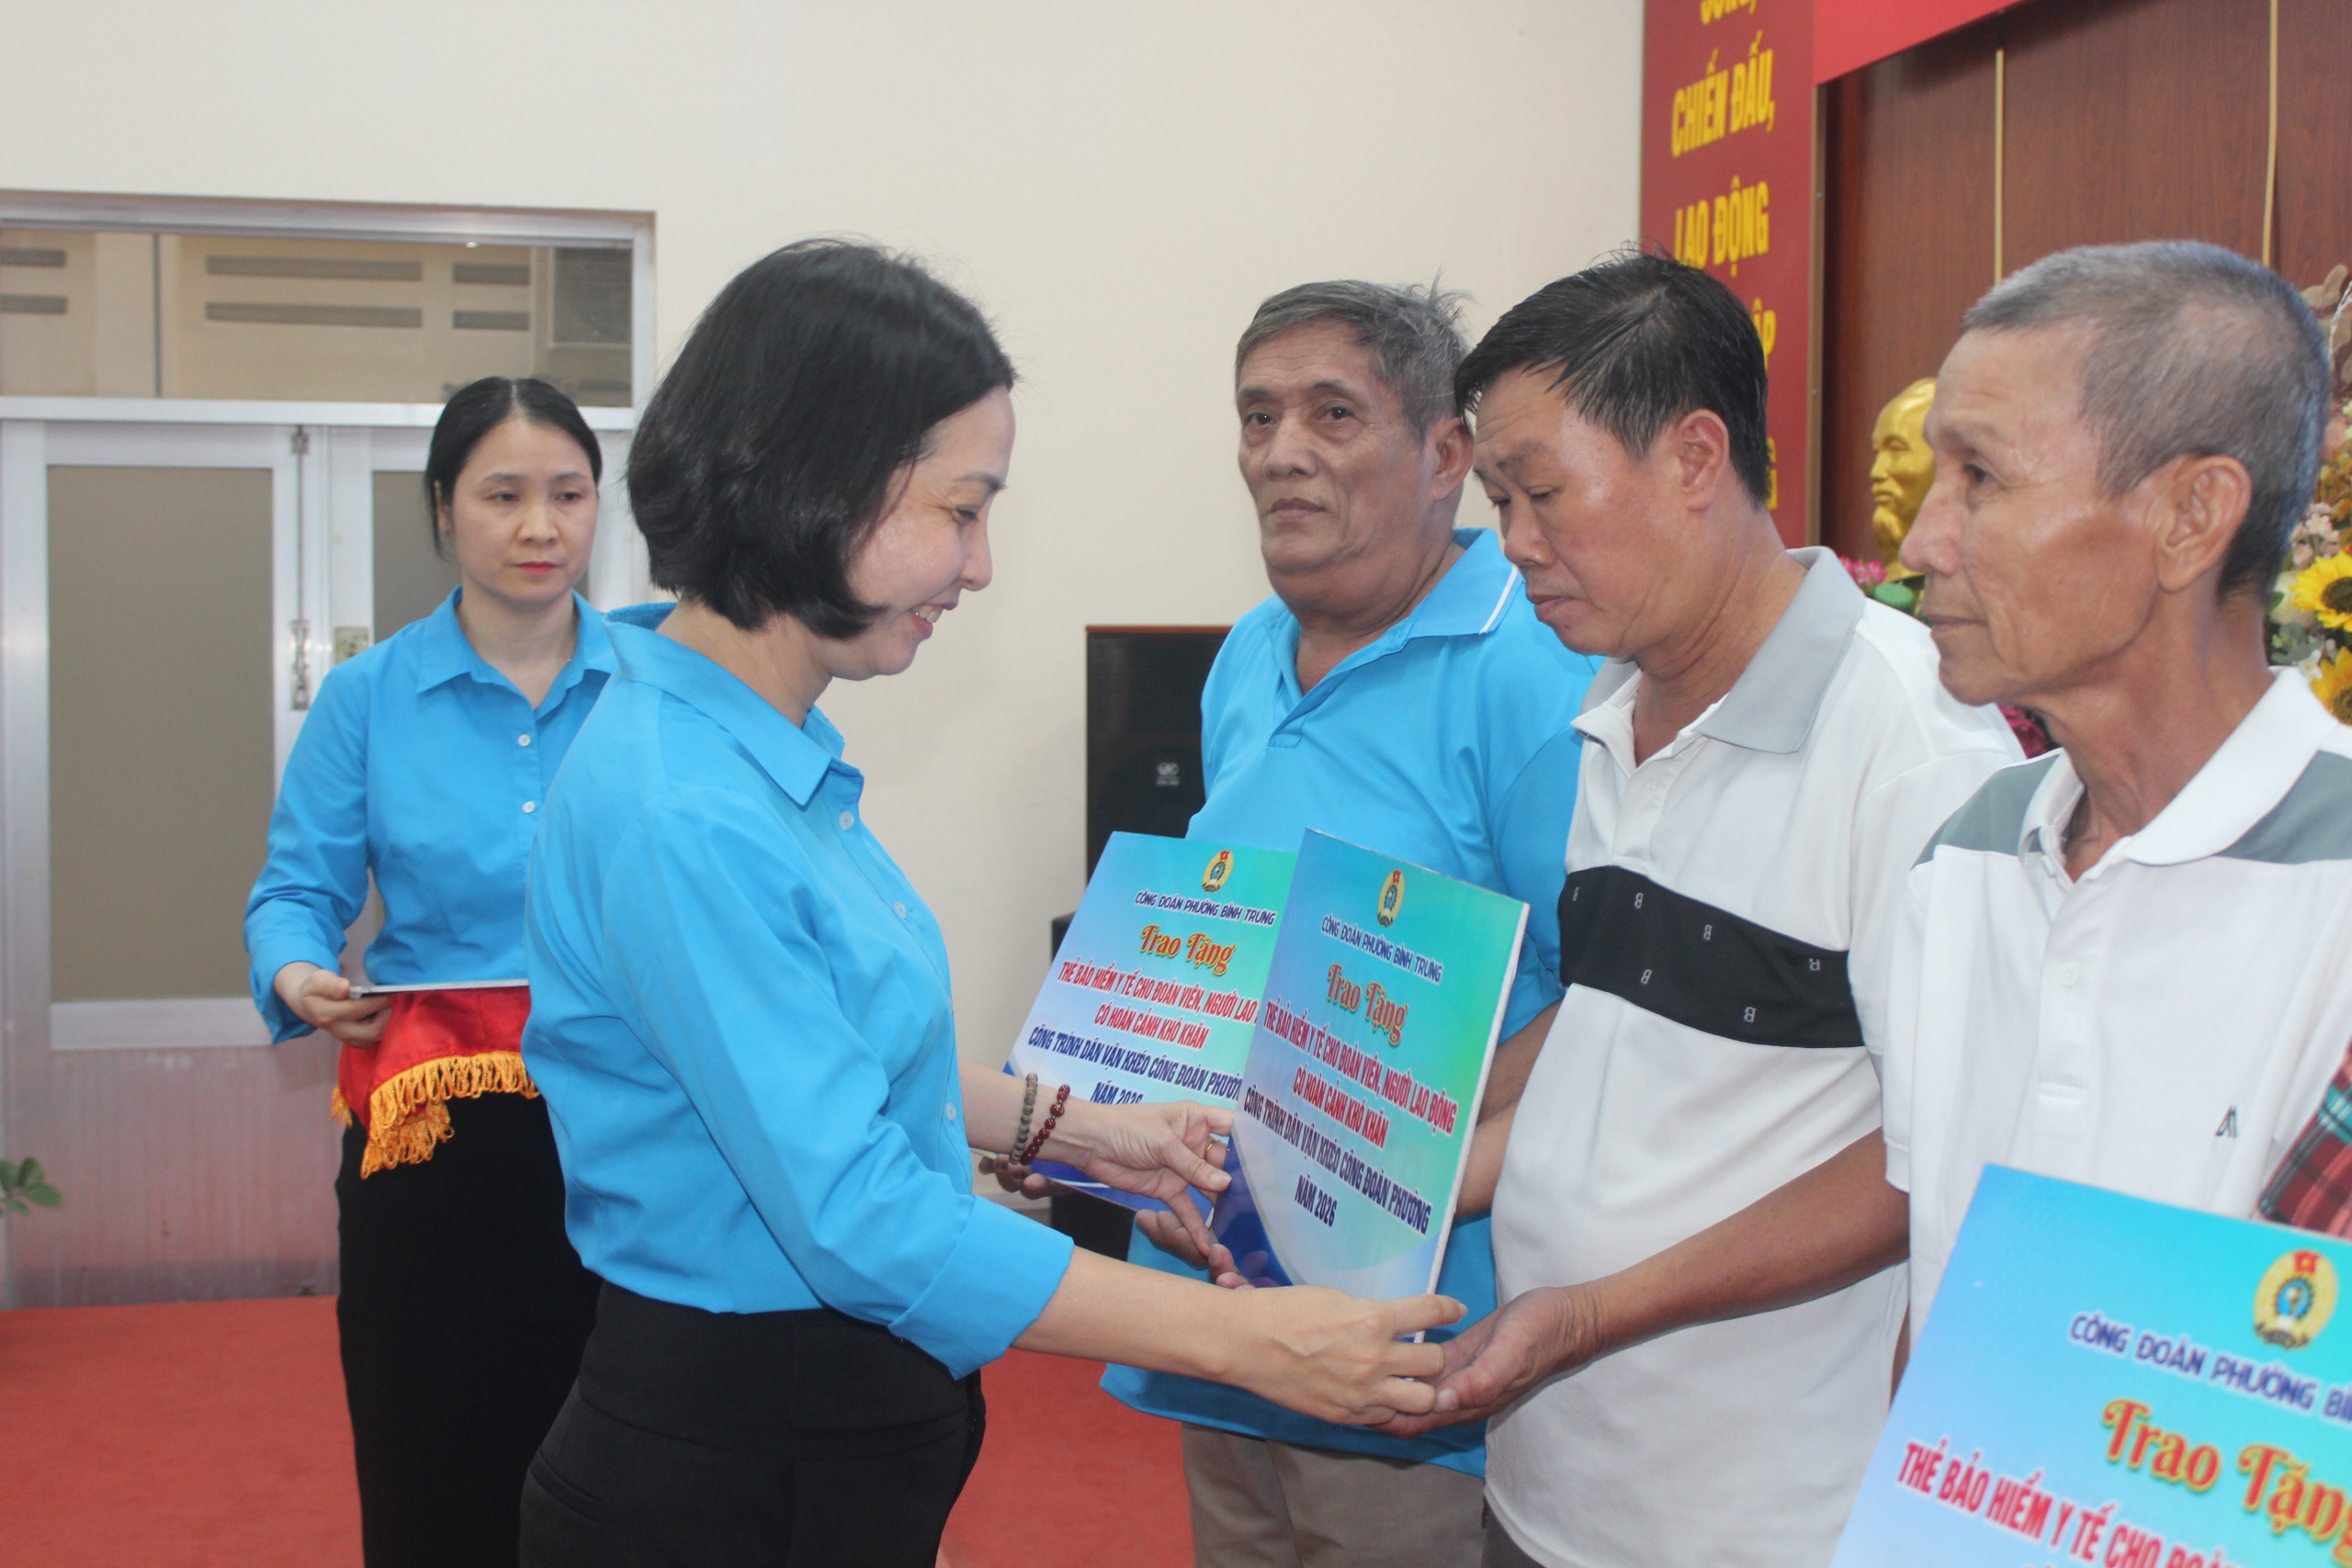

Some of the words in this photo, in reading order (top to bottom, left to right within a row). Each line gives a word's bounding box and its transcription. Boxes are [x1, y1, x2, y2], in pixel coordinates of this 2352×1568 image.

[1671, 48, 1729, 158] CHIẾN
[1730, 30, 1775, 133] ĐẤU,
[1713, 175, 1769, 276] ĐỘNG
[1135, 891, 1158, 907] CÔNG
[1158, 894, 1184, 910] ĐOÀN
[1321, 914, 1340, 937] CÔNG
[1340, 924, 1363, 947] ĐOÀN
[1140, 924, 1182, 957] Trao
[1186, 932, 1237, 975] Tặng
[1057, 956, 1080, 983] THẺ
[1073, 959, 1095, 987] BẢO
[1091, 962, 1117, 991] HIỂM
[1114, 973, 1125, 993] Y
[1121, 969, 1141, 996] TẾ
[1133, 976, 1155, 999] CHO
[1151, 979, 1182, 1006] ĐOÀN
[1178, 983, 1204, 1014] VIÊN,
[1234, 998, 1258, 1022] LAO
[1327, 963, 1362, 1012] Trao
[1365, 982, 1408, 1045] Tặng
[1028, 1024, 1056, 1050] CÔNG
[1052, 1032, 1084, 1058] TRÌNH
[1079, 1037, 1105, 1063] DÂN
[1101, 1043, 1125, 1070] VẬN
[1121, 1050, 1151, 1076] KHÉO
[1148, 1055, 1179, 1083] CÔNG
[1174, 1064, 1209, 1091] ĐOÀN
[1094, 1001, 1114, 1025] CÓ
[1107, 1005, 1136, 1032] HOÀN
[1132, 1007, 1162, 1038] CẢNH
[1157, 1017, 1183, 1043] KHÓ
[1177, 1021, 1210, 1050] KHĂN
[1090, 1079, 1119, 1104] NĂM
[1289, 1010, 1310, 1050] HIỂM
[1306, 1026, 1316, 1053] Y
[1313, 1023, 1329, 1059] TẾ
[1323, 1035, 1340, 1067] CHO
[1338, 1043, 1363, 1081] ĐOÀN
[1409, 1082, 1430, 1119] LAO
[1427, 1089, 1457, 1134] ĐỘNG
[1293, 1064, 1307, 1096] CÓ
[1303, 1072, 1327, 1109] HOÀN
[1324, 1078, 1349, 1122] CẢNH
[1344, 1099, 1366, 1134] KHÓ
[1362, 1108, 1389, 1148] KHĂN
[1243, 1084, 1264, 1121] CÔNG
[1262, 1099, 1287, 1136] TRÌNH
[1283, 1111, 1303, 1148] DÂN
[1300, 1123, 1320, 1160] VẬN
[1317, 1136, 1341, 1174] KHÉO
[1339, 1148, 1364, 1190] CÔNG
[1362, 1166, 1391, 1209] ĐOÀN
[1295, 1173, 1317, 1213] NĂM
[1314, 1189, 1338, 1227] 2026
[2070, 1313, 2131, 1353] CÔNG
[2136, 1337, 2206, 1376] ĐOÀN
[2102, 1398, 2222, 1493] Trao
[1897, 1438, 1948, 1495] THẺ
[1938, 1450, 1990, 1513] BẢO
[1985, 1470, 2053, 1540] HIỂM
[2050, 1501, 2075, 1548] Y
[2070, 1503, 2116, 1562] TẾ
